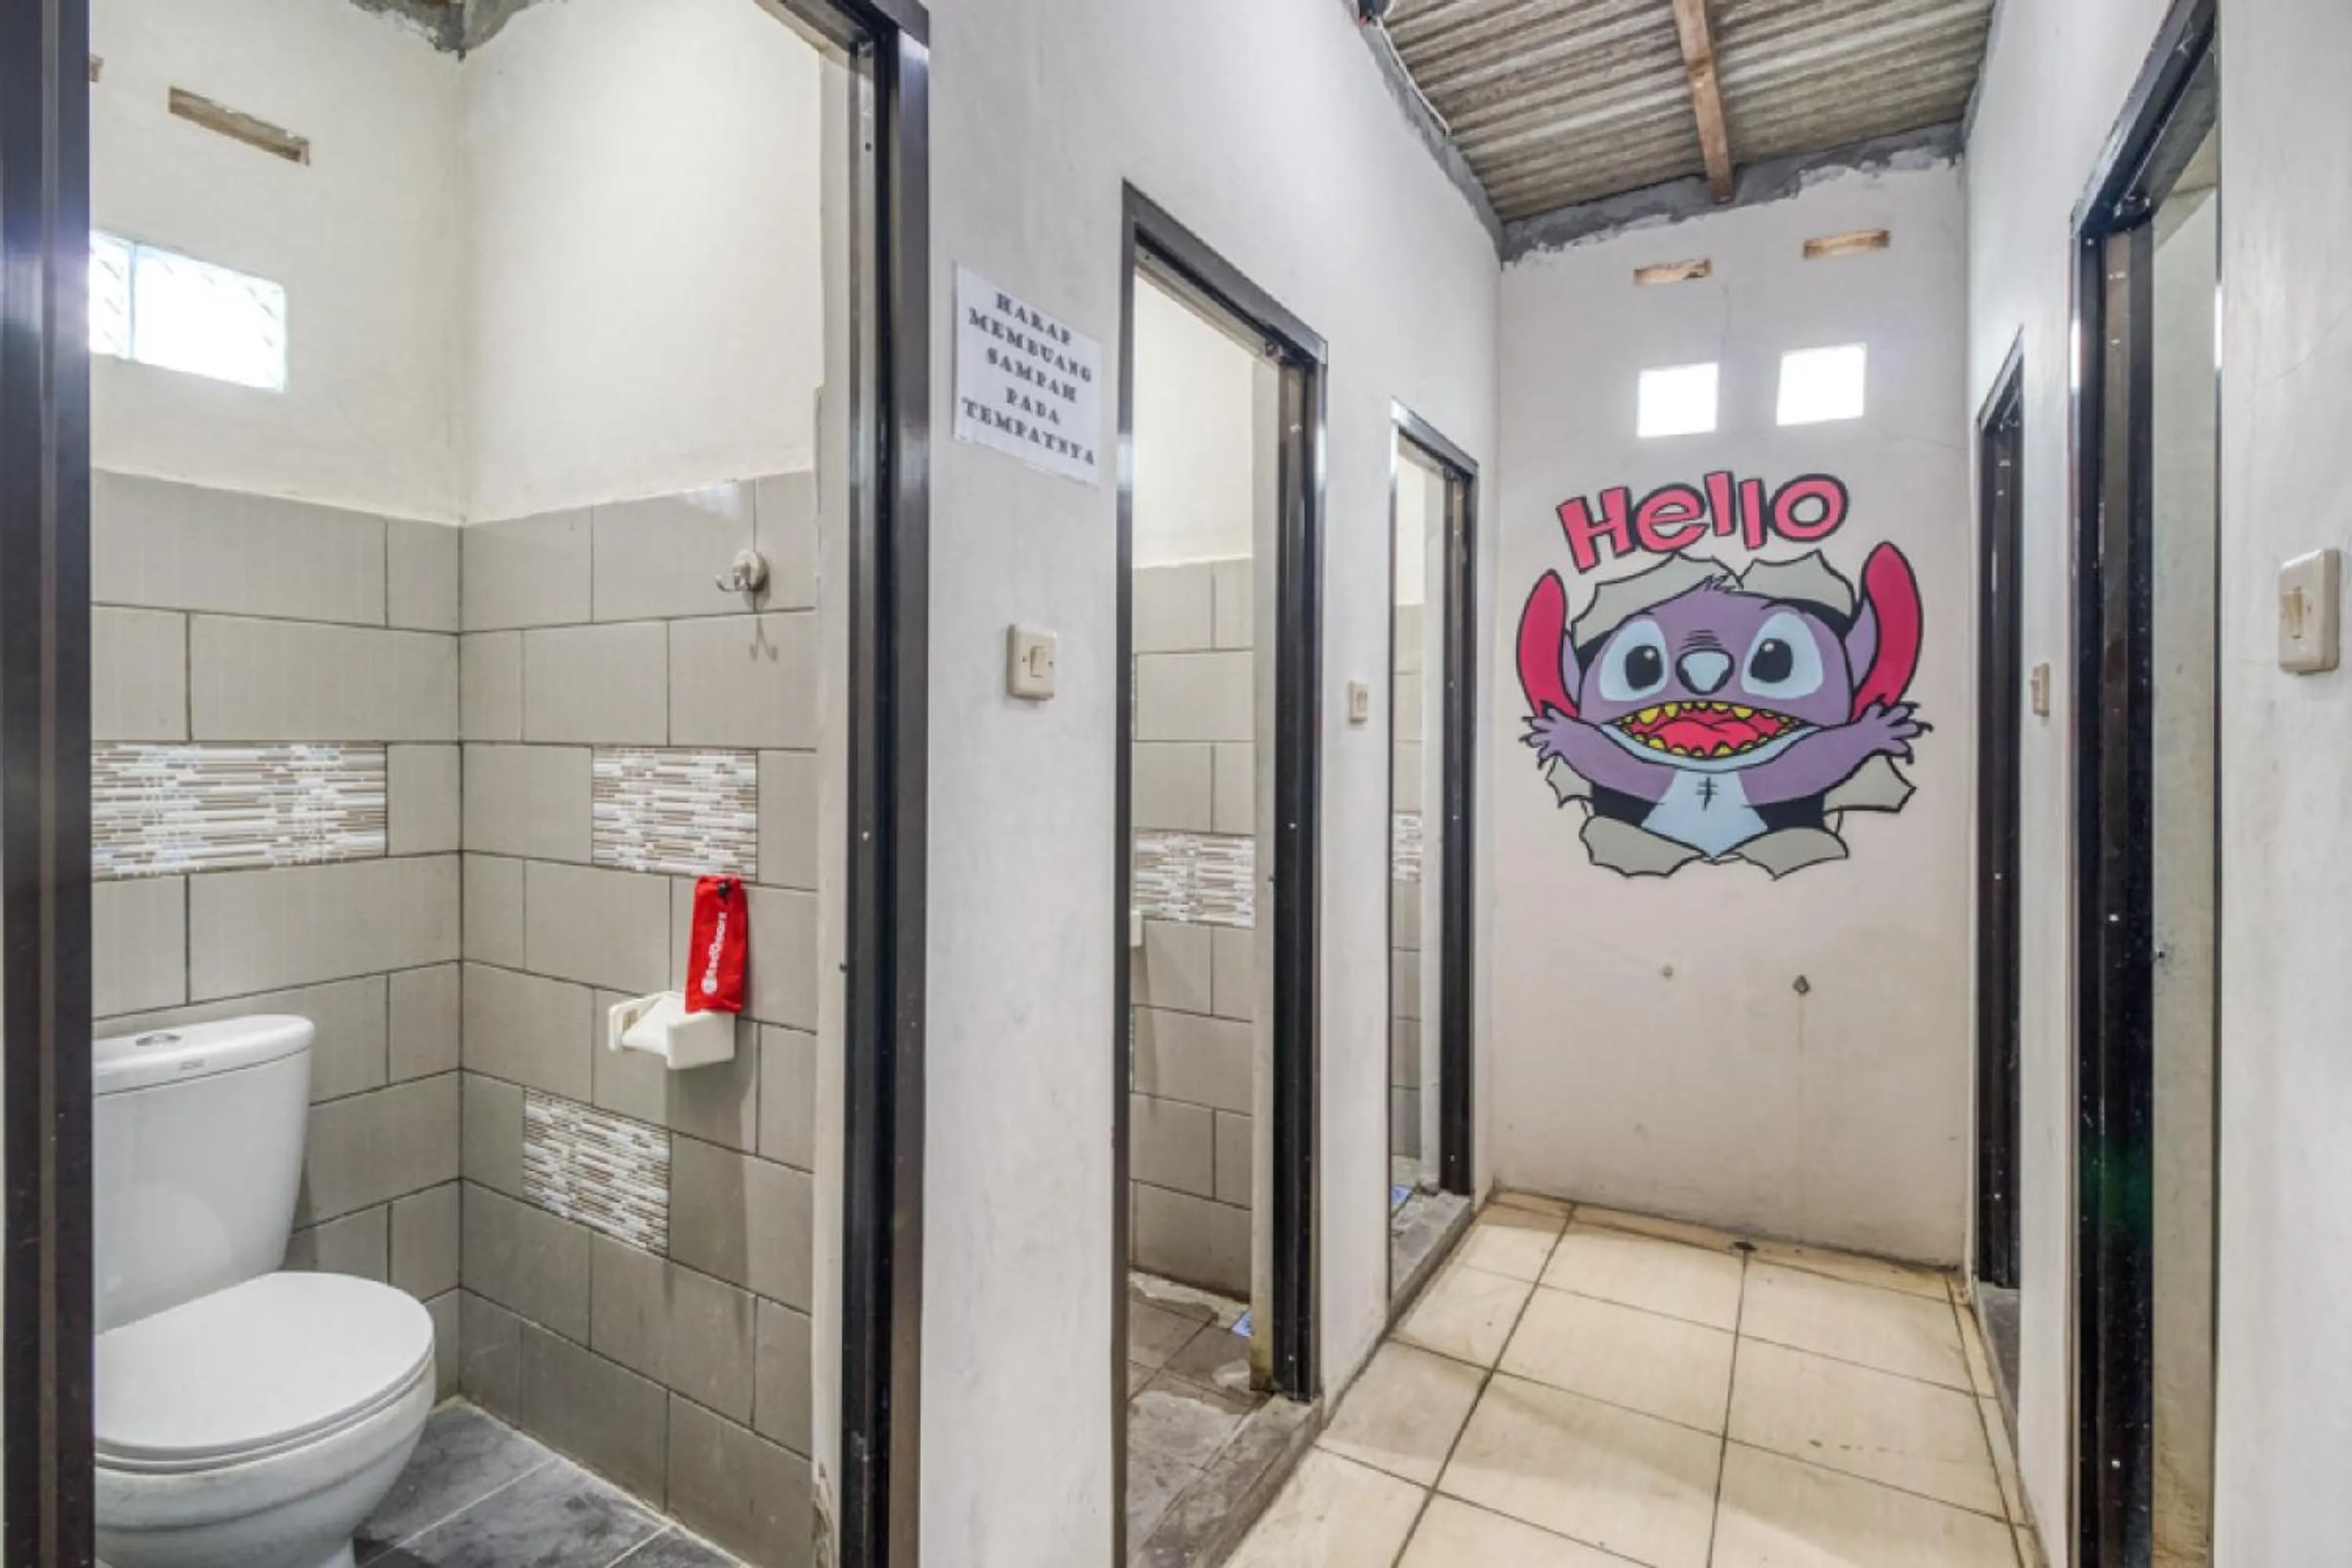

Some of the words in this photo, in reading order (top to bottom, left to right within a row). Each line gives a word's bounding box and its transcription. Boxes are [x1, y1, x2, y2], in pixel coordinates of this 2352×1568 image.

[986, 347, 1077, 403] SAMPAH
[1006, 387, 1060, 425] PADA
[1555, 470, 1849, 575] Hello
